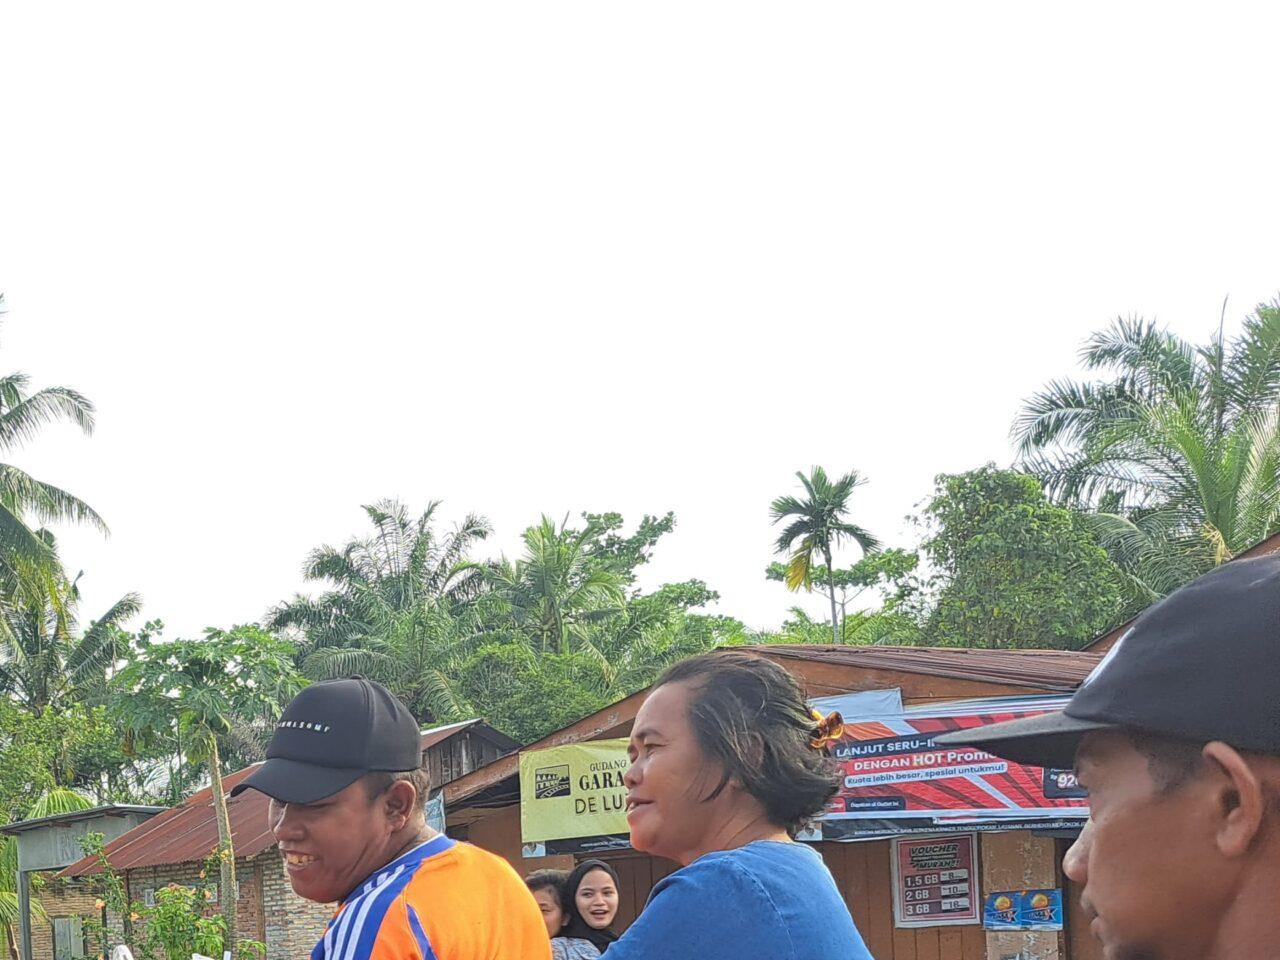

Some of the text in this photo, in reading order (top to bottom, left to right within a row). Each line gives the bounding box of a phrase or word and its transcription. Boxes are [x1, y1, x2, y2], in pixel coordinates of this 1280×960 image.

[836, 744, 885, 757] LANJUT
[854, 757, 910, 771] DENGAN
[912, 752, 945, 767] HOT
[579, 770, 626, 791] GARA
[847, 763, 1005, 785] Kuota lebih besar, spesial untukmu!
[574, 792, 629, 815] DE LU
[910, 843, 959, 855] VOUCHER
[905, 875, 923, 887] 1.5
[924, 874, 939, 885] GB
[906, 891, 913, 901] 2
[915, 889, 930, 900] GB
[906, 905, 914, 915] 3
[916, 903, 930, 914] GB
